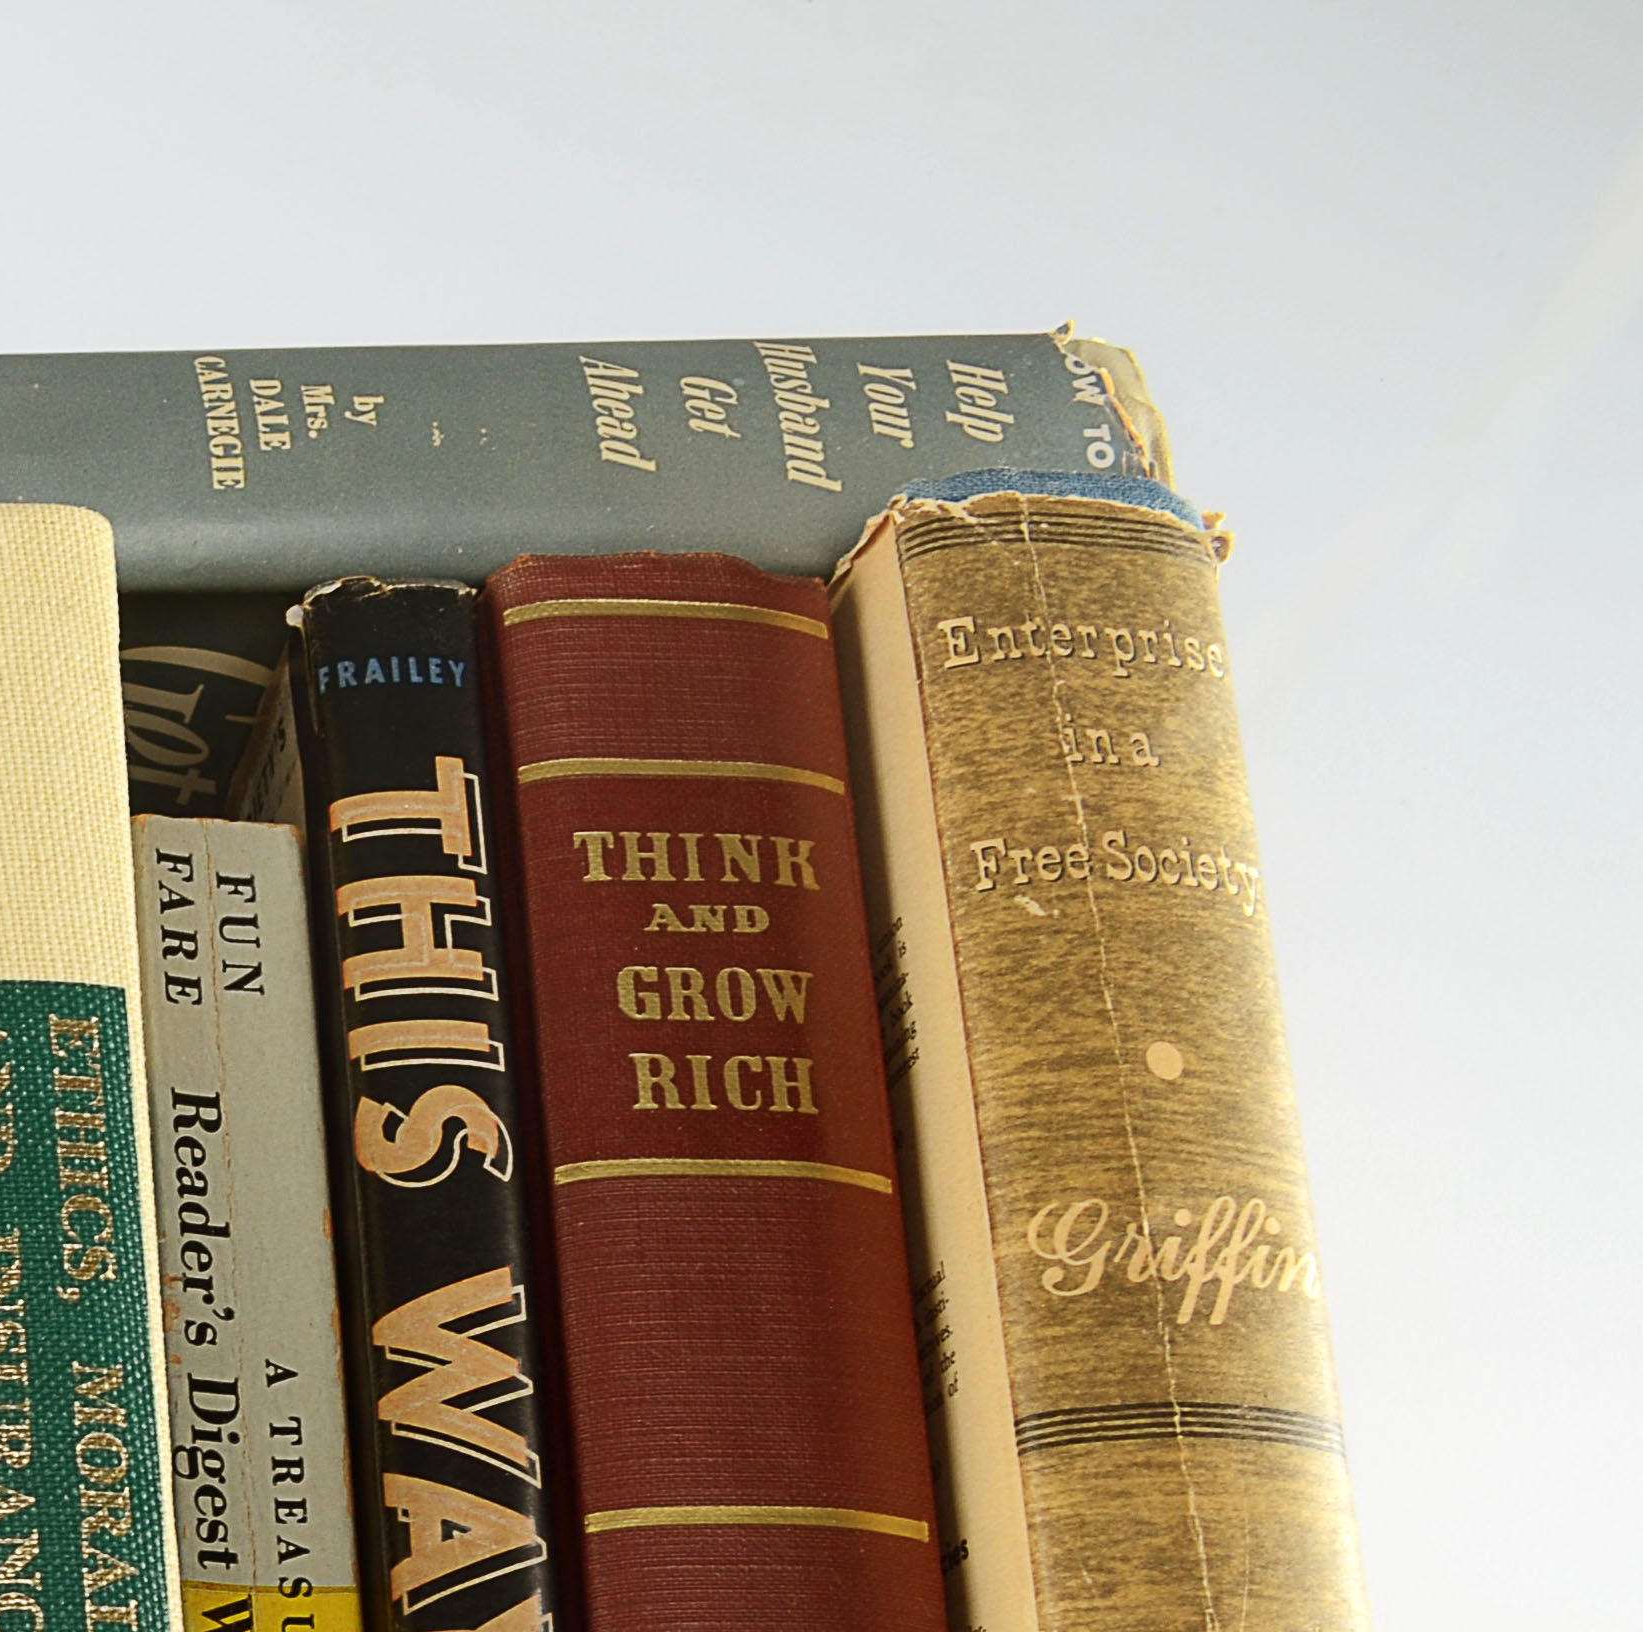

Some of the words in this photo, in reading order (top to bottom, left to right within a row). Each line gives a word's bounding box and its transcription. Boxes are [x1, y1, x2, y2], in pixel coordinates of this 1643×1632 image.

[248, 378, 292, 452] DALE
[300, 383, 336, 440] Mrs.
[344, 394, 385, 426] by
[578, 354, 657, 474] Ahead
[678, 374, 744, 440] Get
[856, 360, 918, 450] Your
[944, 359, 1016, 443] Help
[1065, 353, 1106, 405] OW
[192, 354, 247, 491] CARNEGIE
[754, 340, 844, 493] Husband
[1083, 423, 1116, 469] TO
[318, 655, 467, 695] FRAILEY
[937, 614, 1227, 679] Enterprise
[1062, 712, 1122, 765] in
[1128, 729, 1161, 768] a
[572, 830, 820, 891] THINK
[969, 836, 1092, 892] Free
[1101, 829, 1261, 919] Society
[155, 847, 203, 1007] FARE
[216, 870, 266, 997] FUN
[643, 902, 771, 934] AND
[328, 755, 514, 1189] THIS
[616, 965, 814, 1026] GROW
[627, 1051, 820, 1115] RICH
[47, 1013, 117, 1304] ETHICS,
[170, 1086, 237, 1348] Reader's
[1025, 1194, 1321, 1326] Griffin
[264, 1358, 299, 1389] A
[172, 1372, 241, 1571] Digest
